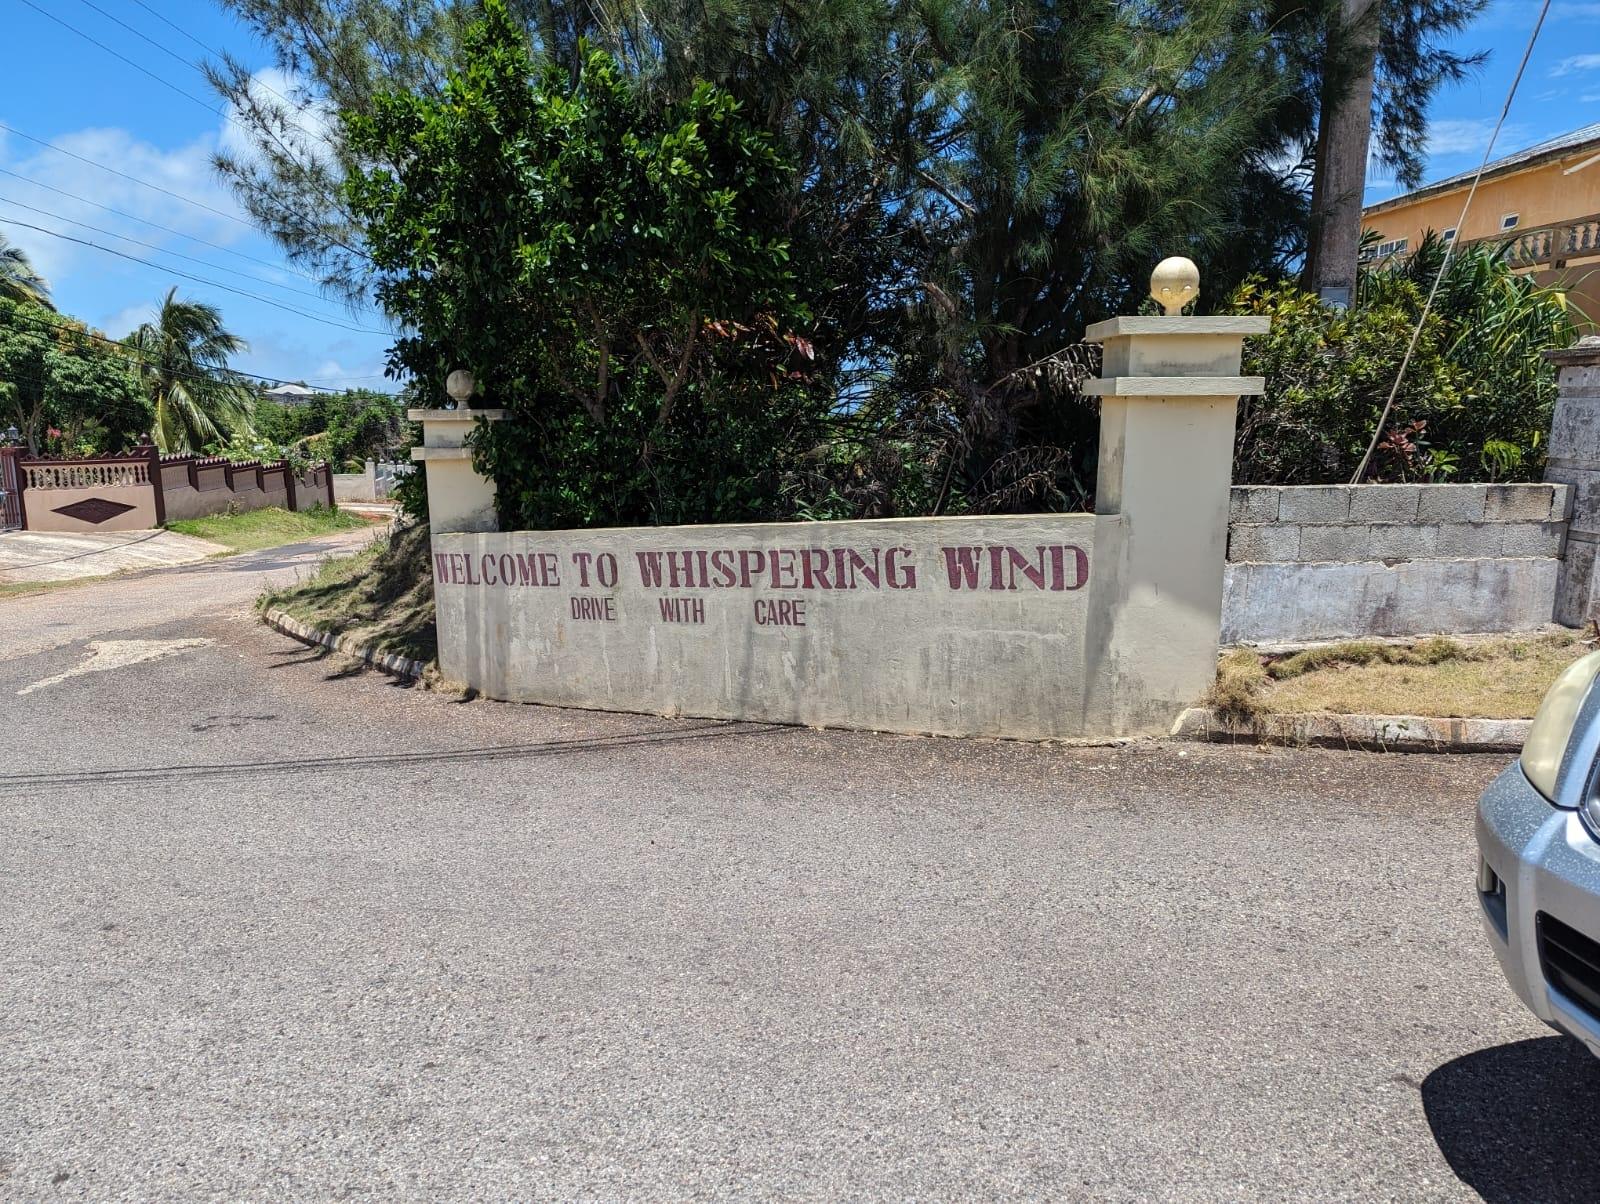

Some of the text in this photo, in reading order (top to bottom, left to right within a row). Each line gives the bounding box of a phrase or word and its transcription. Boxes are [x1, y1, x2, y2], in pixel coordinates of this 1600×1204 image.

[434, 545, 1090, 592] WELCOME TO WHISPERING WIND
[570, 597, 806, 626] DRIVE WITH CARE
